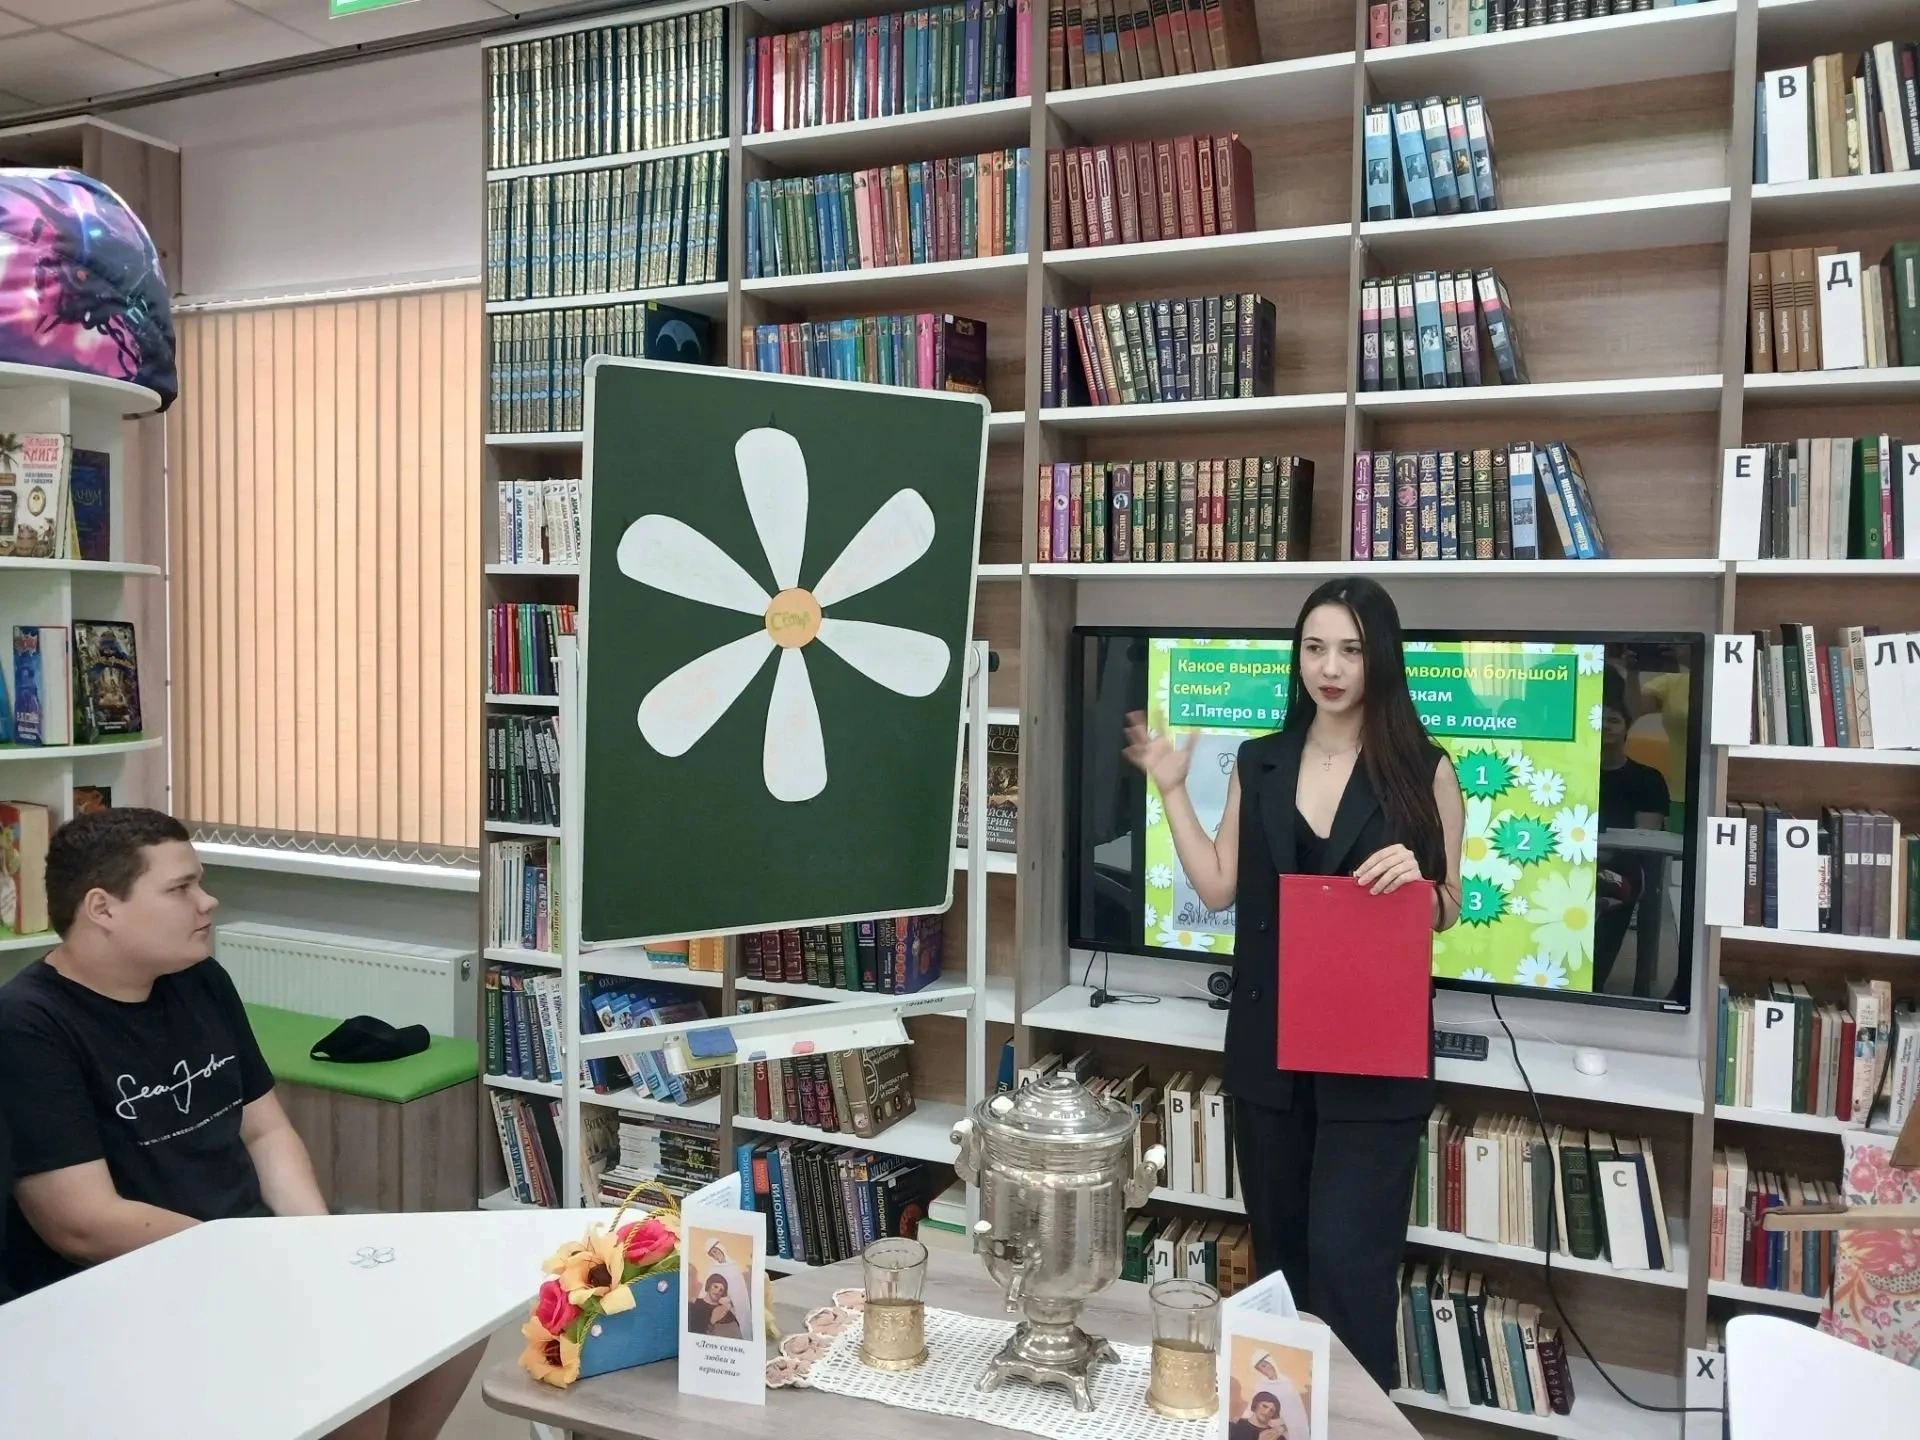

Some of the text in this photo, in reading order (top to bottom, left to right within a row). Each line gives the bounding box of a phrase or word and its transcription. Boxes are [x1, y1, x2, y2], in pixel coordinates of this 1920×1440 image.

[1779, 76, 1796, 98] В
[1827, 261, 1852, 290] Д
[1736, 456, 1751, 478] Е
[1185, 508, 1194, 537] ЧЕХОВ
[1405, 510, 1415, 550] ВИЗБОР
[1725, 642, 1742, 663] К
[1804, 633, 1815, 674] КОРНИЛОВ
[1875, 642, 1896, 666] Л
[1177, 659, 1224, 673] Какое
[1481, 665, 1567, 681] большой
[1172, 681, 1231, 696] семьи?
[1180, 703, 1265, 721] 2.Пятеро в
[1446, 715, 1455, 726] в
[1460, 715, 1516, 730] лодке
[1474, 766, 1487, 785] 1
[1515, 831, 1530, 851] 2
[1717, 824, 1736, 845] Н
[1786, 826, 1809, 848] О
[1748, 824, 1757, 886] СЕРГЕЙ НАРОВЧАТОВ
[1865, 855, 1871, 864] 2
[1468, 891, 1481, 910] 3
[1767, 1008, 1783, 1028] Р
[488, 1017, 496, 1059] БИОЛОГИЯ
[503, 1020, 512, 1061] ХИМИЯ
[518, 1021, 529, 1063] ФИЗИКА
[531, 1024, 542, 1070] МАТЕМАТИКА
[1173, 1098, 1184, 1113] В
[1211, 1102, 1220, 1117] Г
[1477, 1146, 1488, 1162] Р
[742, 1152, 753, 1204] ЖИВОПИСЬ
[1613, 1170, 1628, 1187] С
[771, 1183, 787, 1256] МИФОЛОГИЯ
[876, 1186, 887, 1232] МИФОЛОГИЯ
[1155, 1252, 1168, 1267] Л
[1188, 1248, 1205, 1266] М
[1436, 1306, 1453, 1323] Ф
